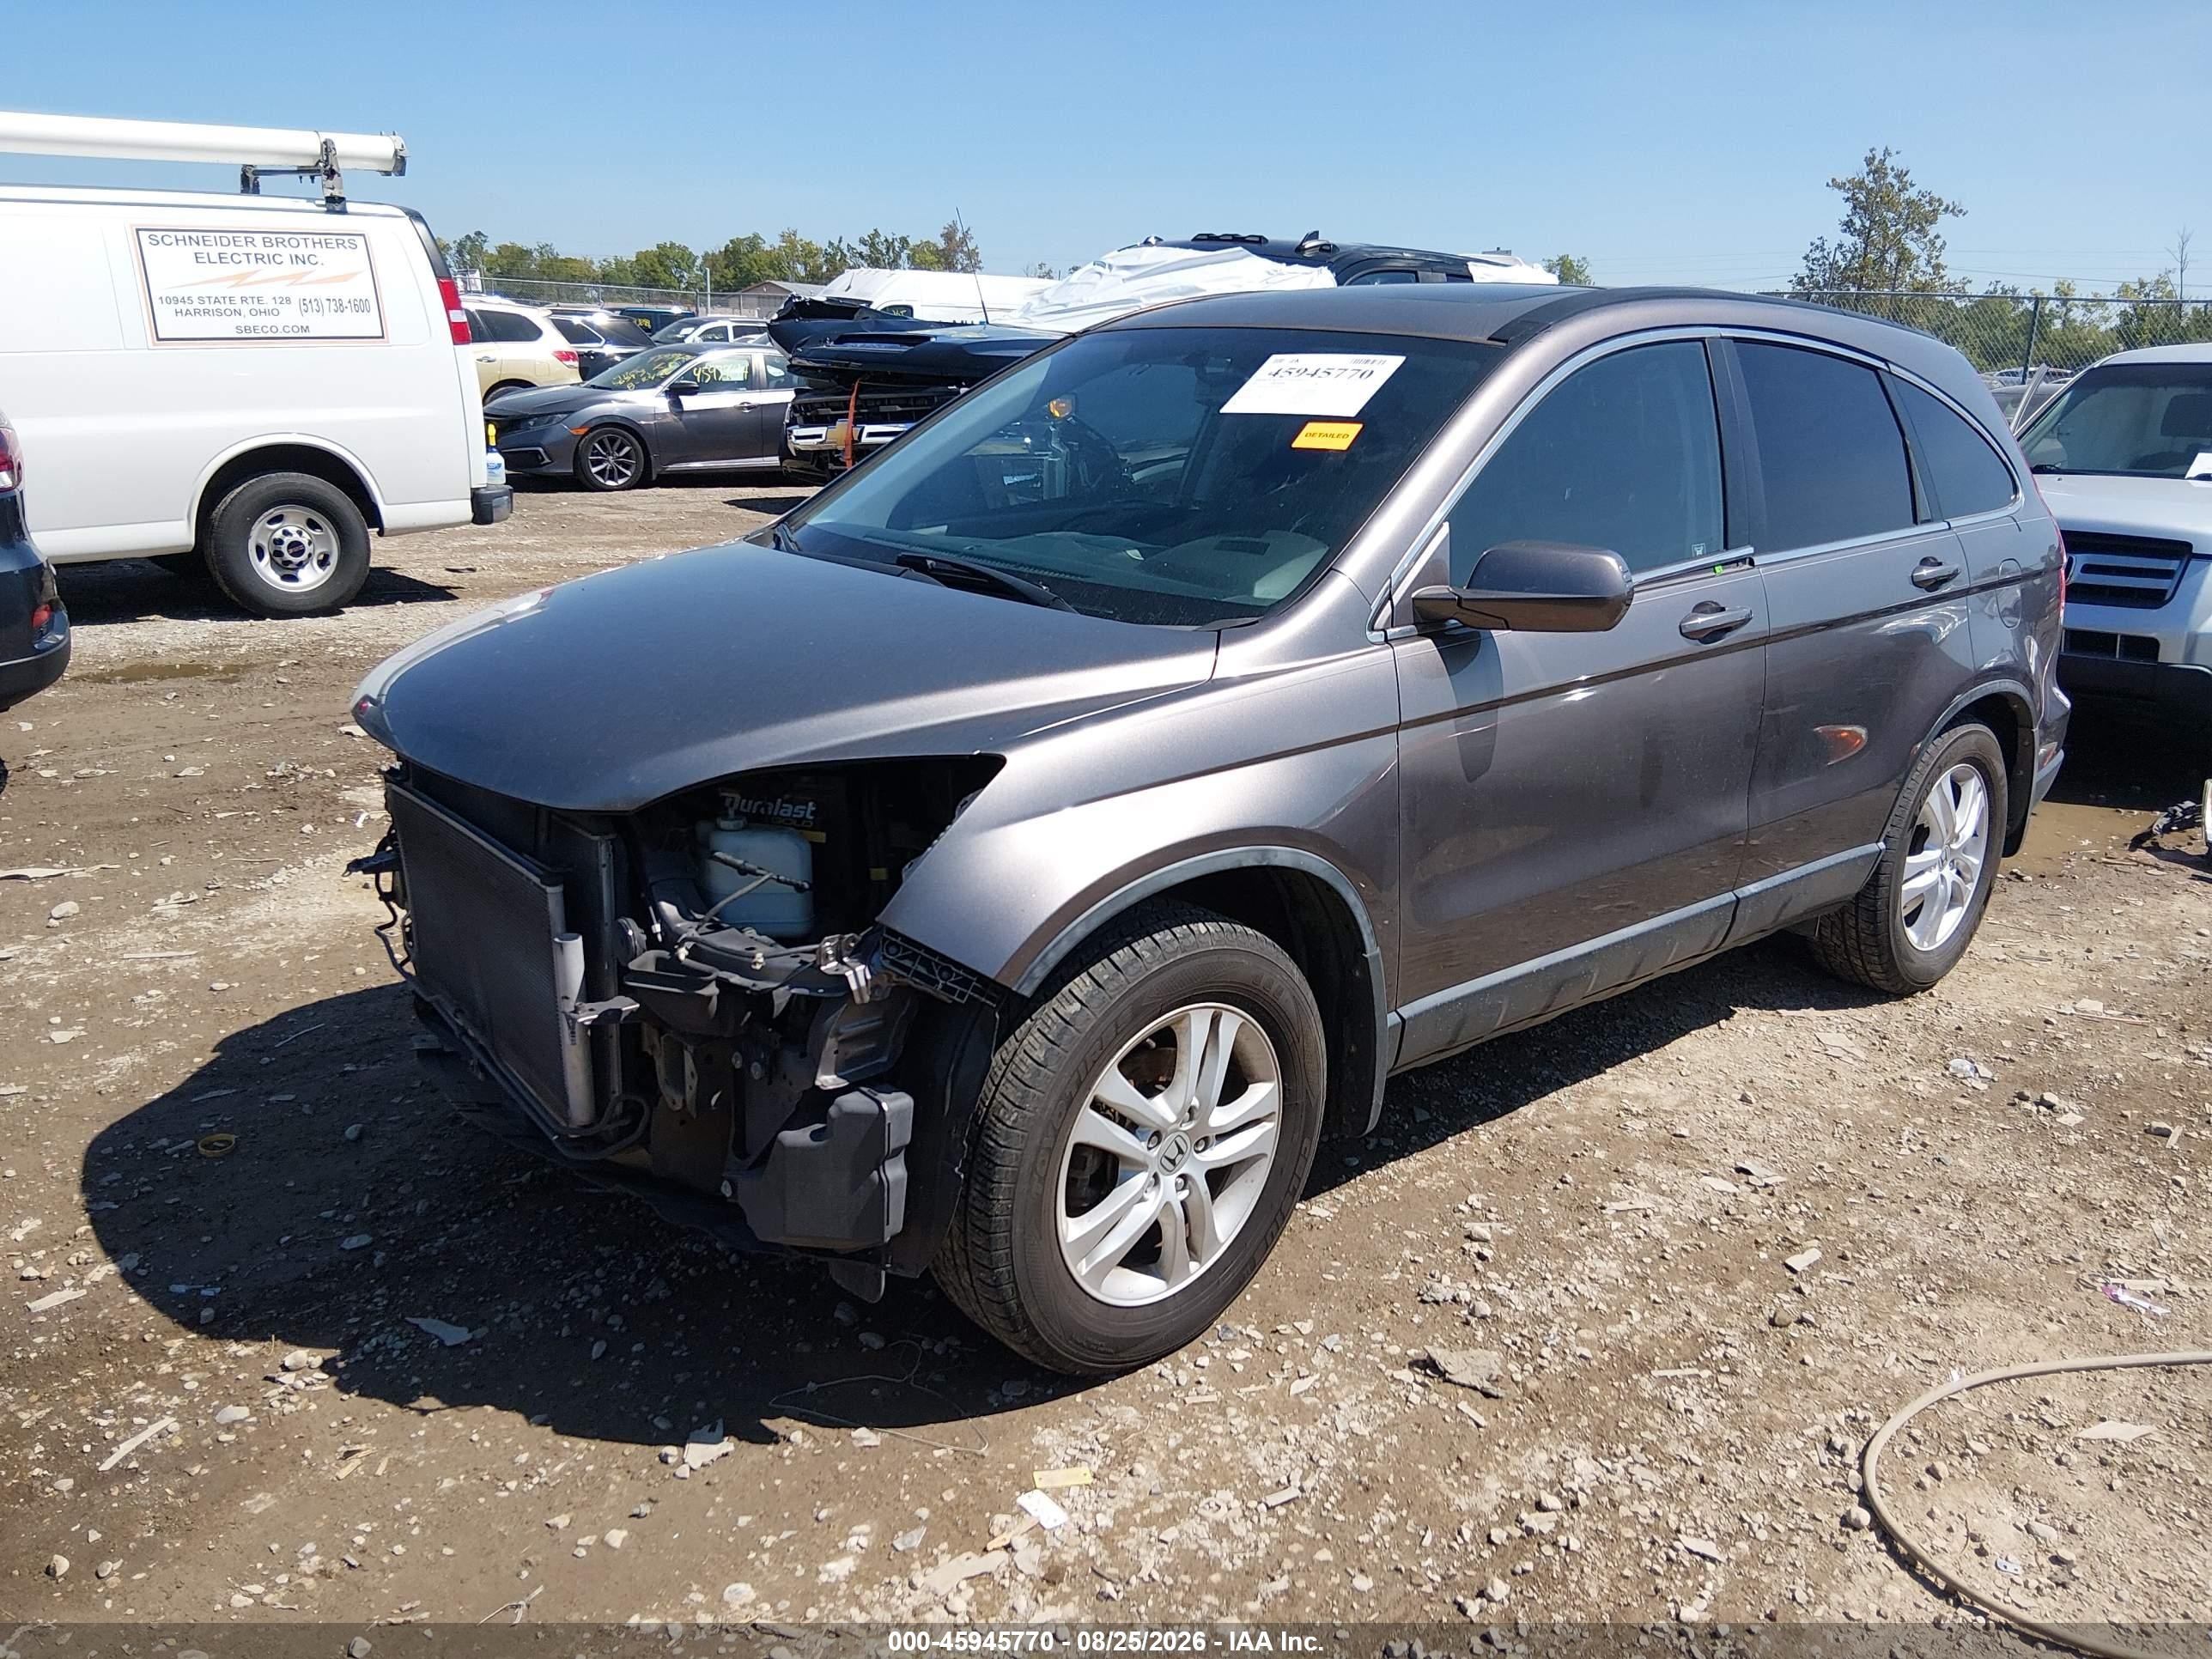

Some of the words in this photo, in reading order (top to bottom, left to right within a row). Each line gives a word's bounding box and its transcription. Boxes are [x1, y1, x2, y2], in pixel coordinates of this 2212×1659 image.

[148, 234, 258, 247] SCHNEIDER
[262, 236, 358, 250] BROTHERS
[194, 252, 284, 265] ELECTRIC
[289, 253, 325, 266] INC.
[158, 295, 194, 305] 10945
[198, 295, 237, 305] STATE
[272, 295, 292, 305] 128
[174, 307, 246, 319] HARRISON,
[249, 307, 280, 317] OHIO
[298, 297, 325, 317] (513)
[325, 297, 371, 313] 738-1600
[234, 325, 311, 334] SBECO.COM
[1267, 368, 1375, 380] 45945770
